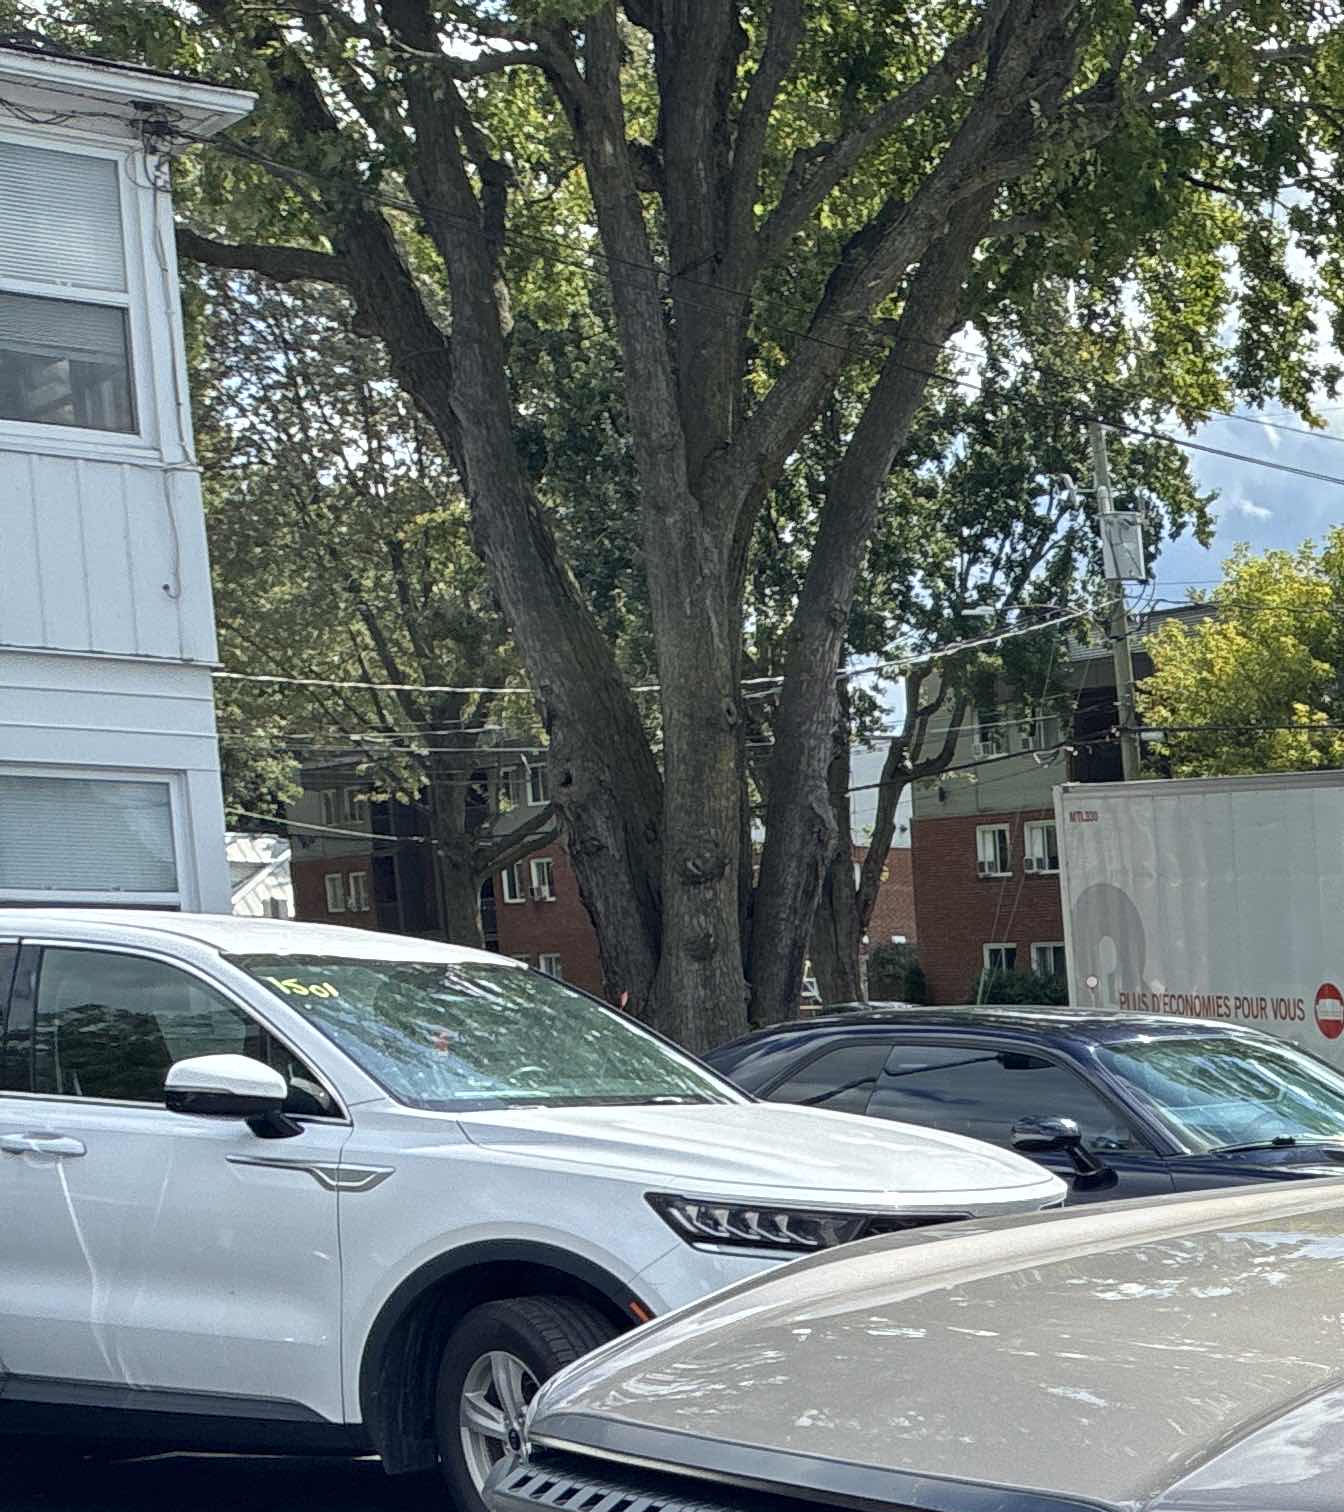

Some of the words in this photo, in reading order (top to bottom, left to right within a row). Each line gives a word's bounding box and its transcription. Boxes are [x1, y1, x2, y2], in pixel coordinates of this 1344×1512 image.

[1119, 992, 1150, 1011] PLUS
[1234, 996, 1267, 1021] POUR
[1270, 998, 1305, 1021] VOUS
